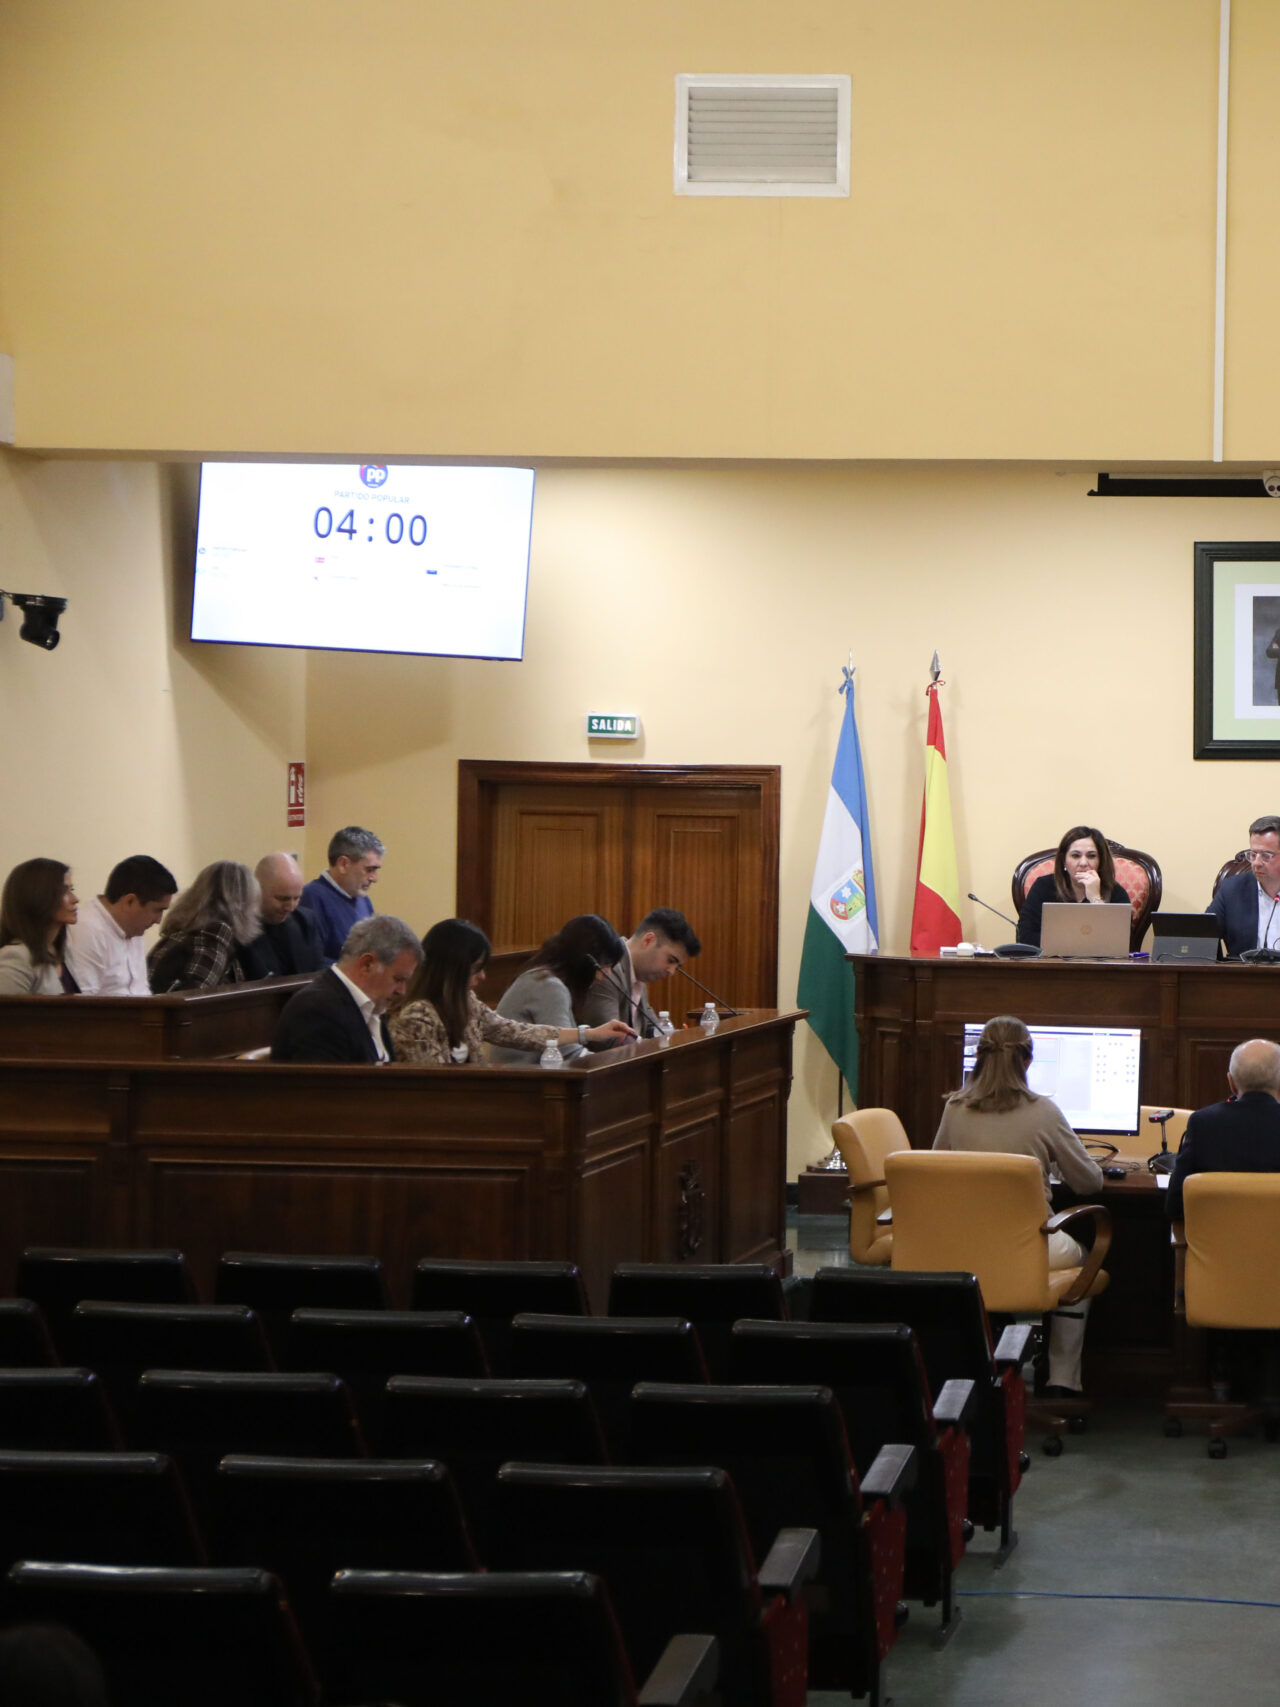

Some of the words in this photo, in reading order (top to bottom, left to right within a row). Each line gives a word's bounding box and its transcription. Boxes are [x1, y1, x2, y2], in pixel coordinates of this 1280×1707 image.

[334, 489, 370, 501] PARTIDO
[371, 494, 411, 504] POPULAR
[313, 506, 428, 546] 04:00
[591, 718, 632, 731] SALIDA
